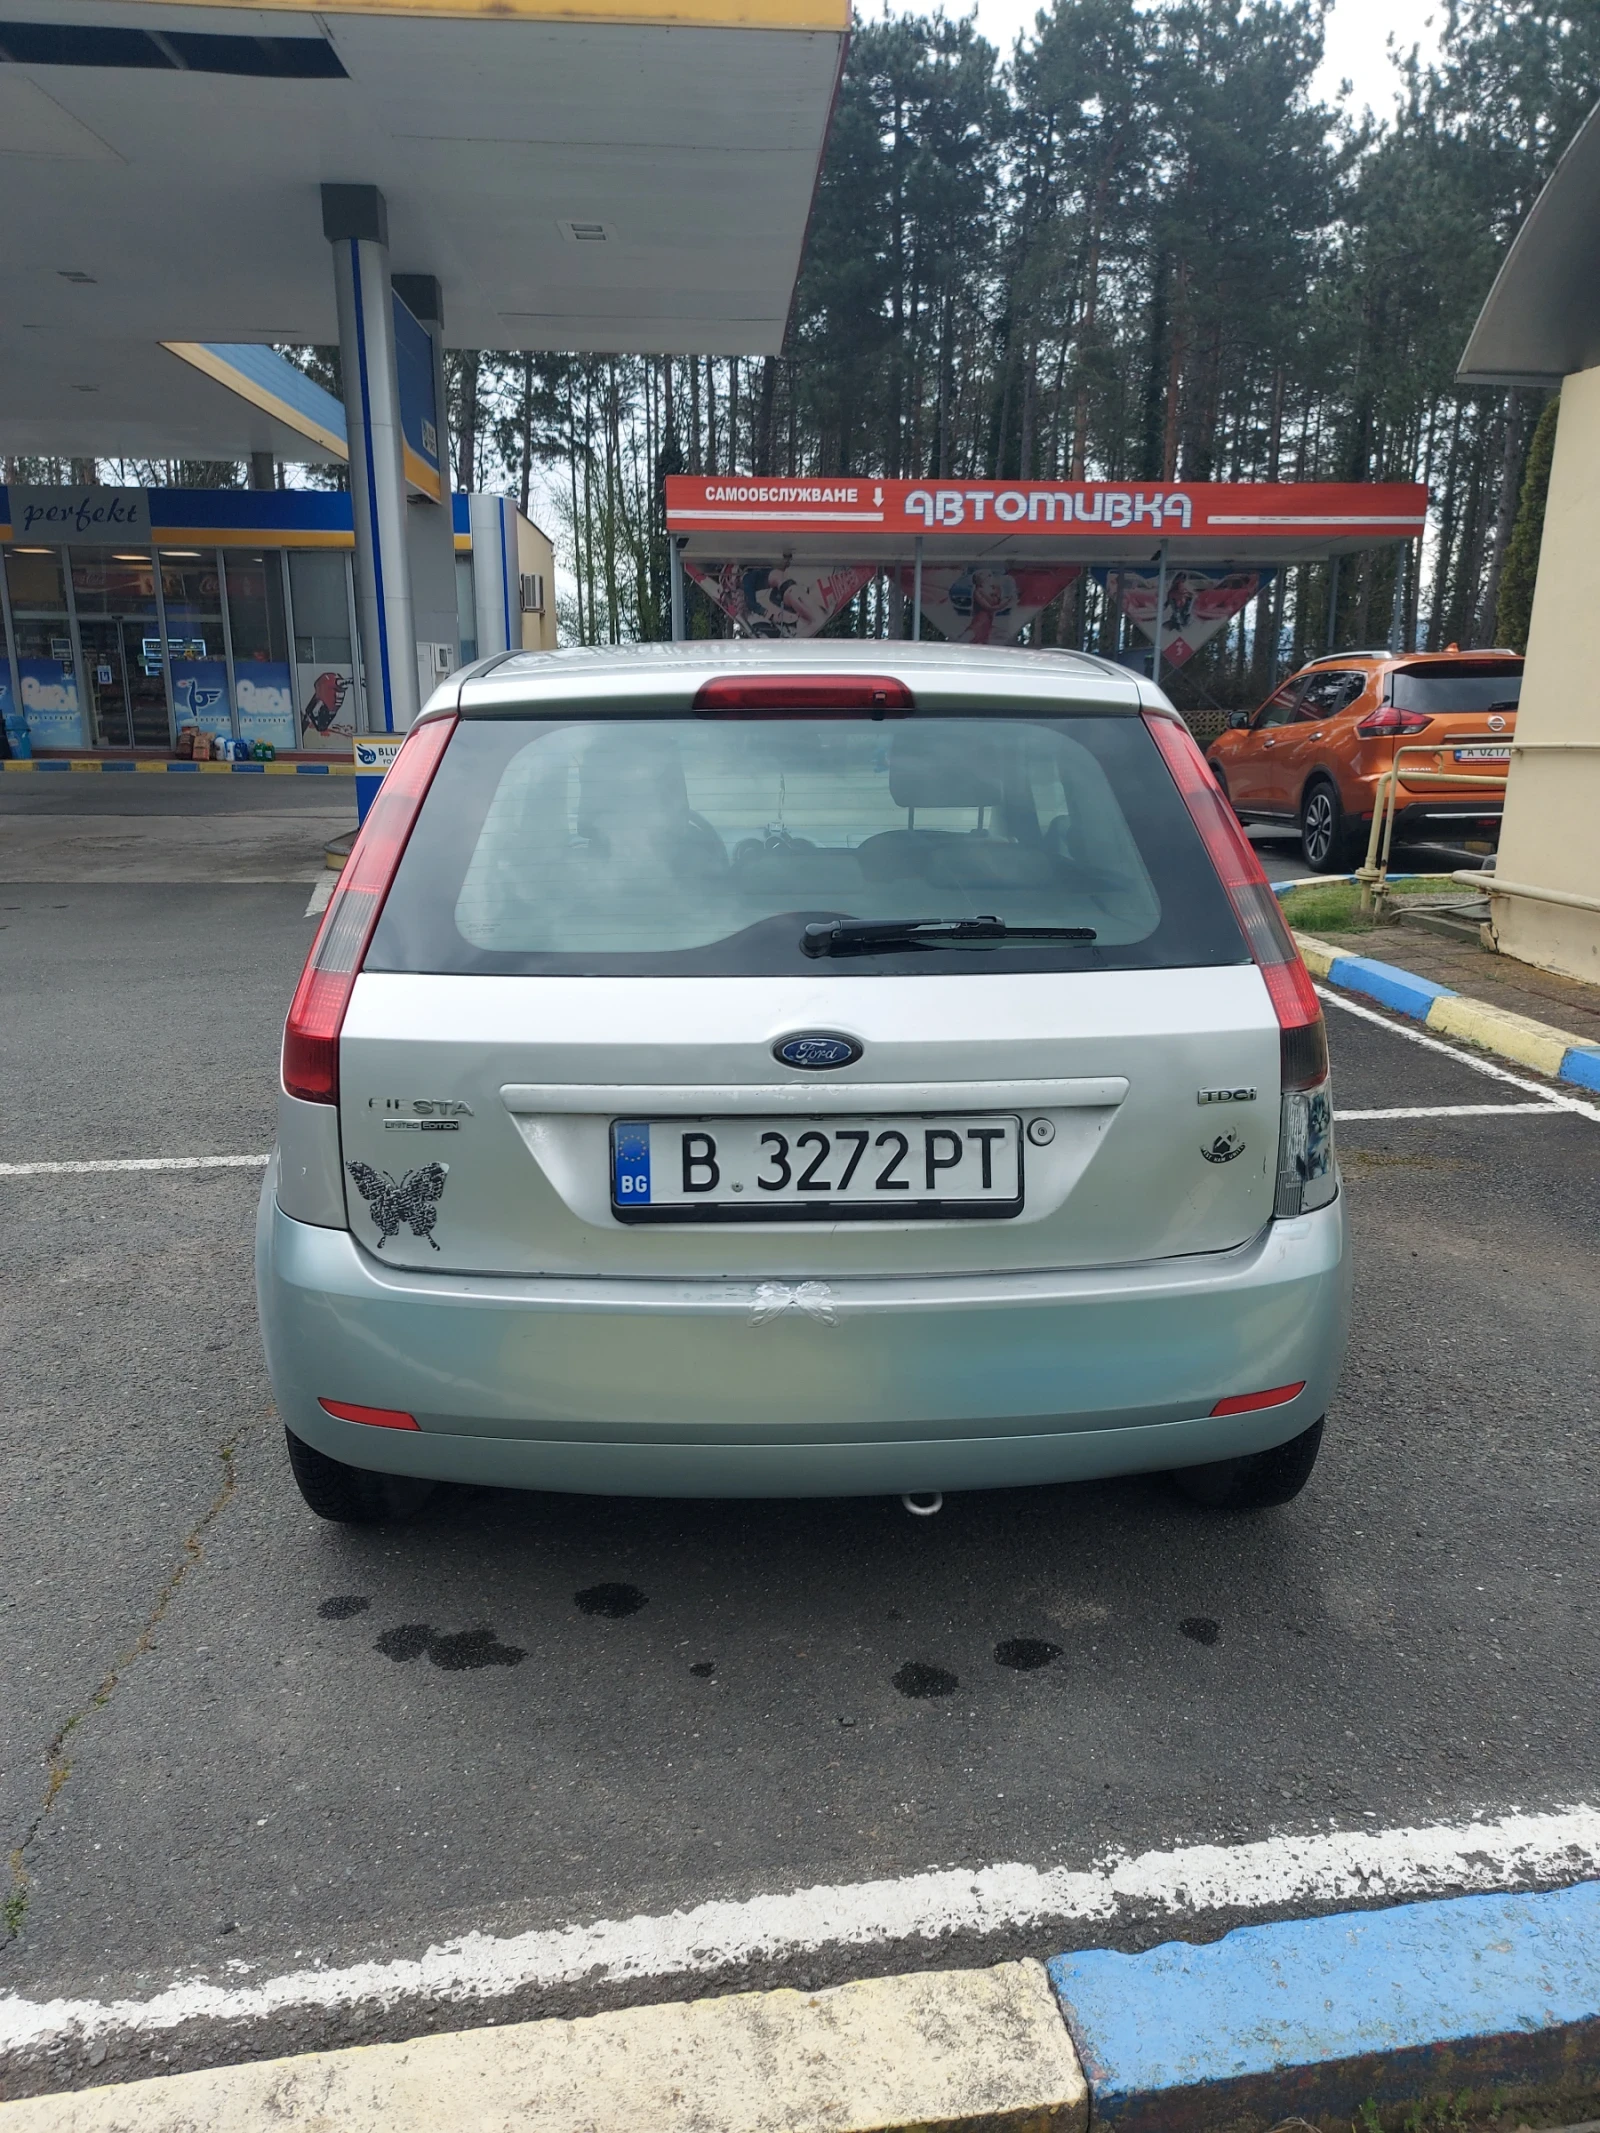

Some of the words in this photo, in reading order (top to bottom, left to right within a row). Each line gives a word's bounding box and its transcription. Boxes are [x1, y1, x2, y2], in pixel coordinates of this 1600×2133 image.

[705, 486, 858, 503] САМООБСЛУЖВАНЕ
[23, 497, 138, 532] perfekt
[378, 747, 400, 757] BLU
[795, 1041, 839, 1060] Ford
[1201, 1088, 1255, 1102] TDCi
[368, 1098, 475, 1117] FIESTA
[682, 1132, 720, 1193] B
[621, 1175, 648, 1193] BG
